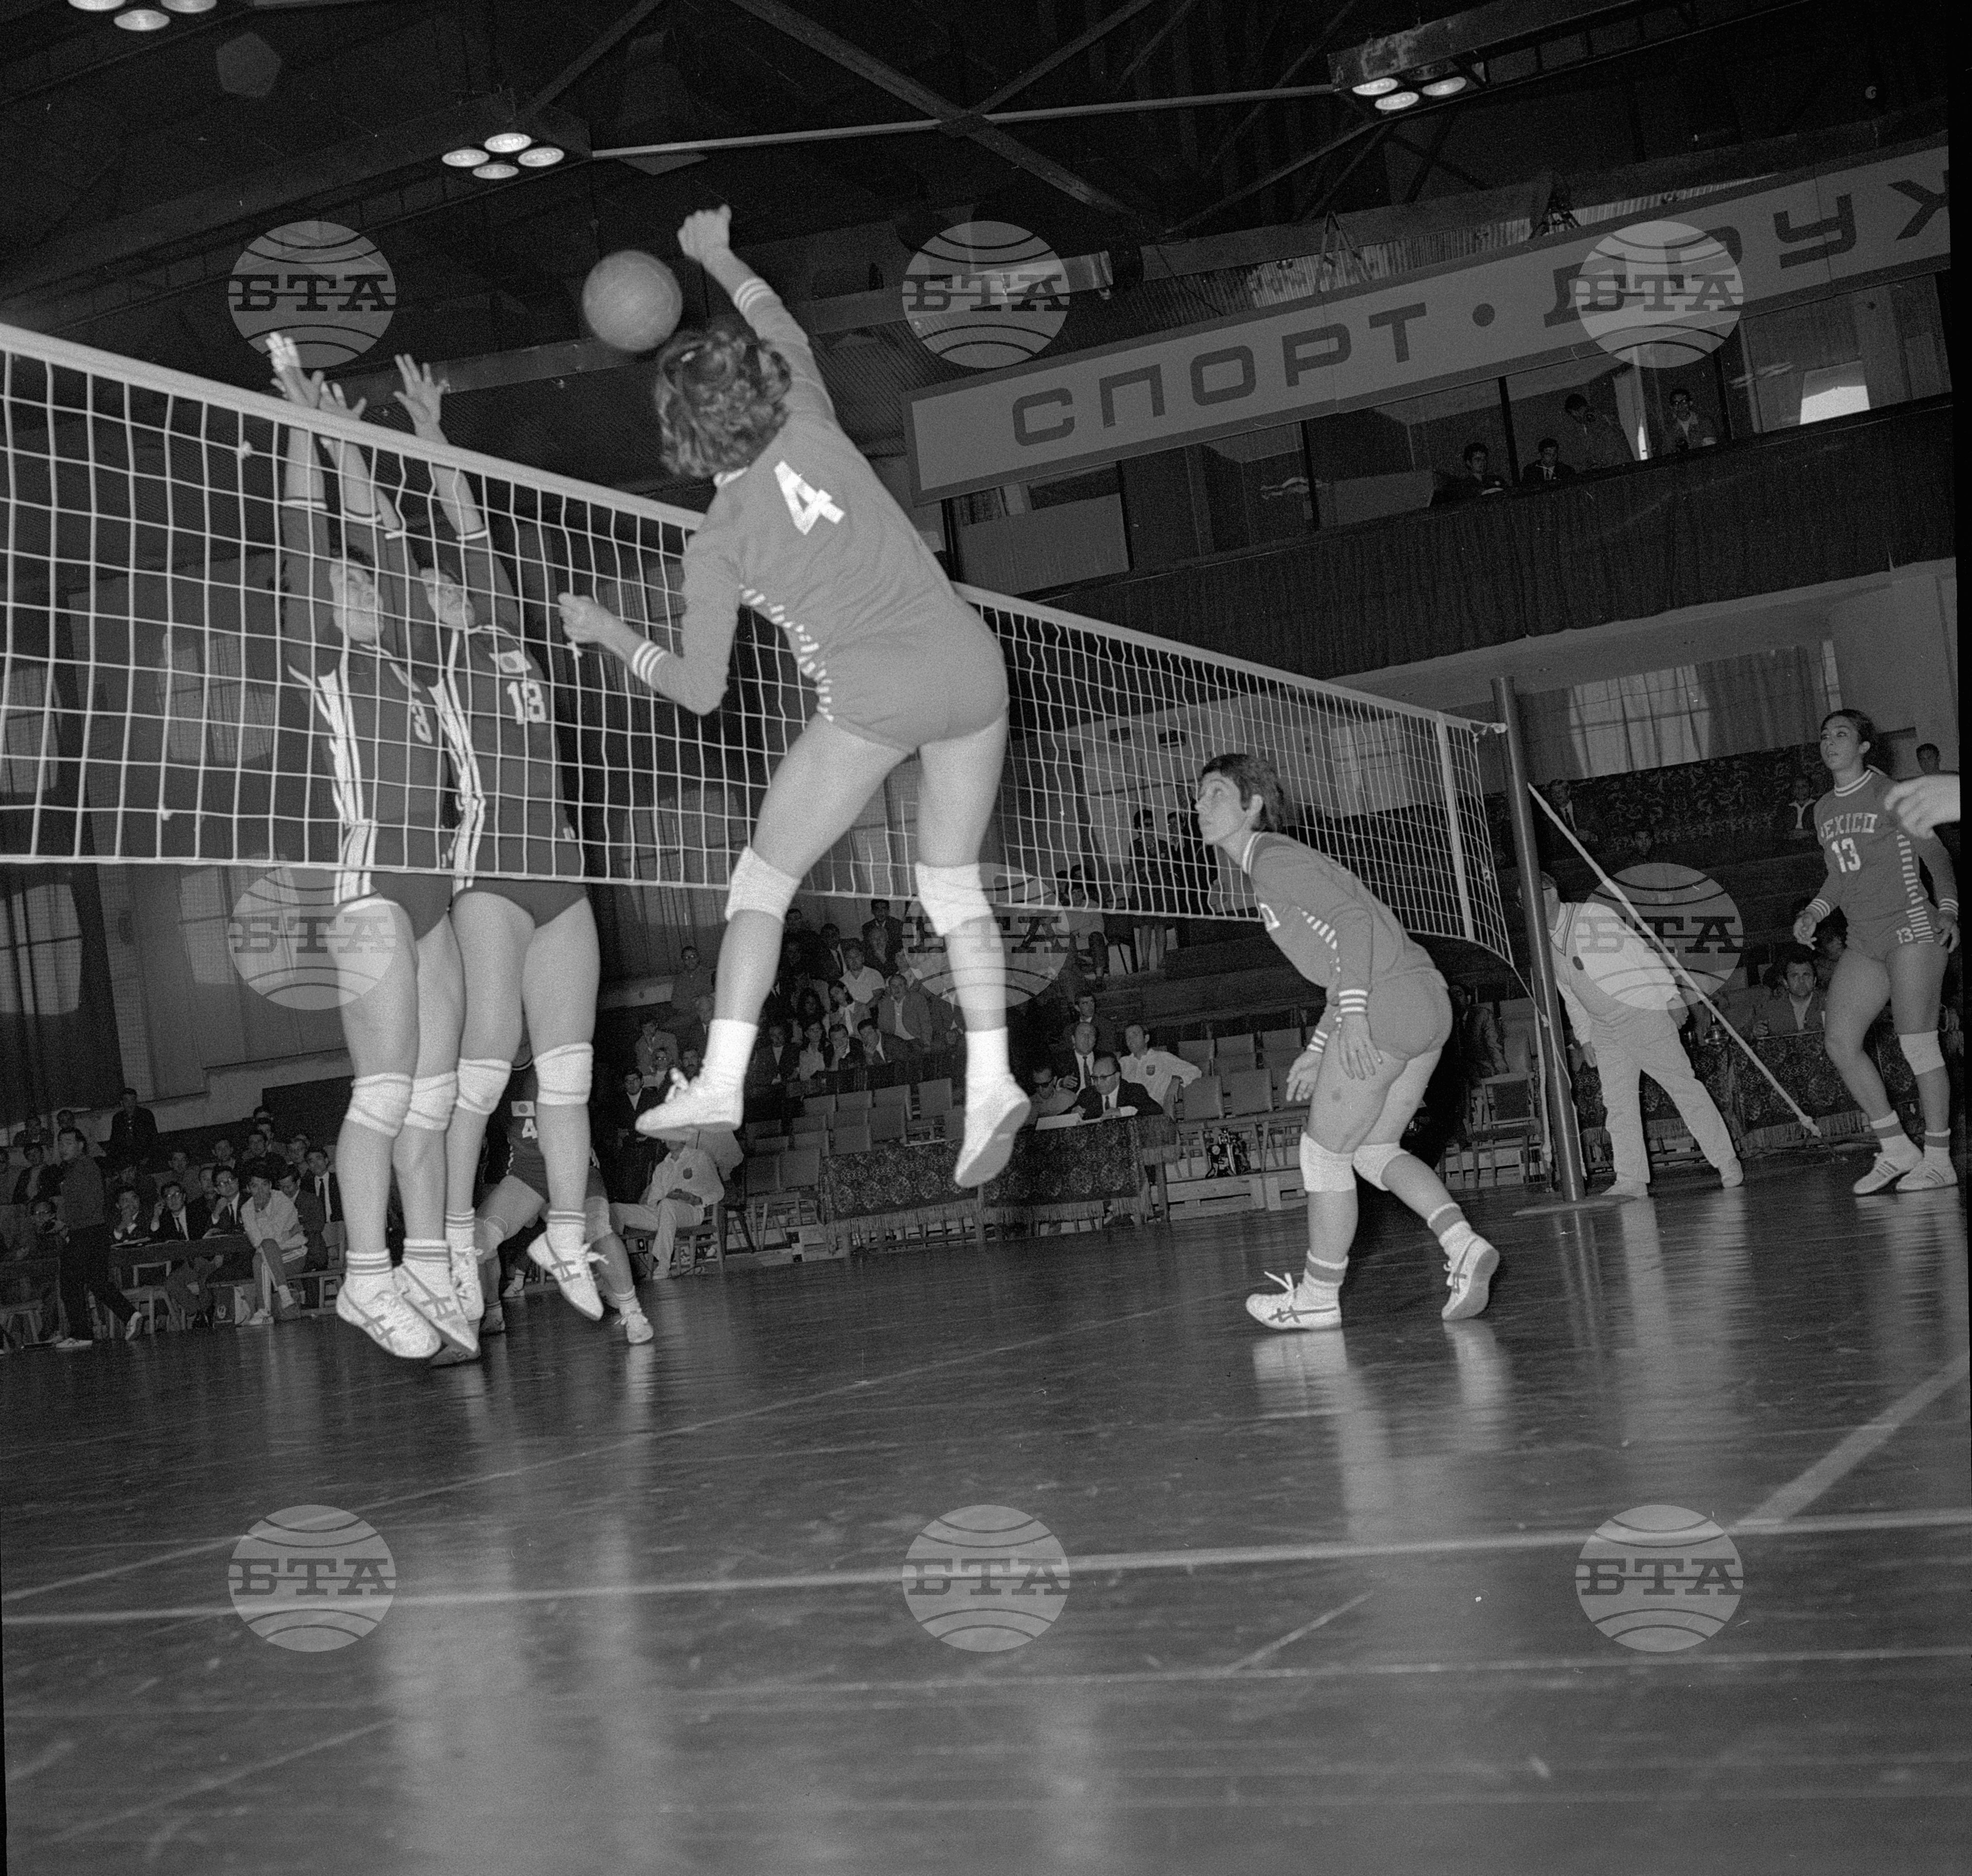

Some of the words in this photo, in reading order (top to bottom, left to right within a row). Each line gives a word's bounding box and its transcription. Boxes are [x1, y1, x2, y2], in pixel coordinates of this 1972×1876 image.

[1012, 303, 1426, 446] СПОРТ
[775, 461, 845, 535] 4
[1832, 838, 1861, 872] 13
[1896, 927, 1913, 944] 13
[522, 1118, 537, 1139] 4
